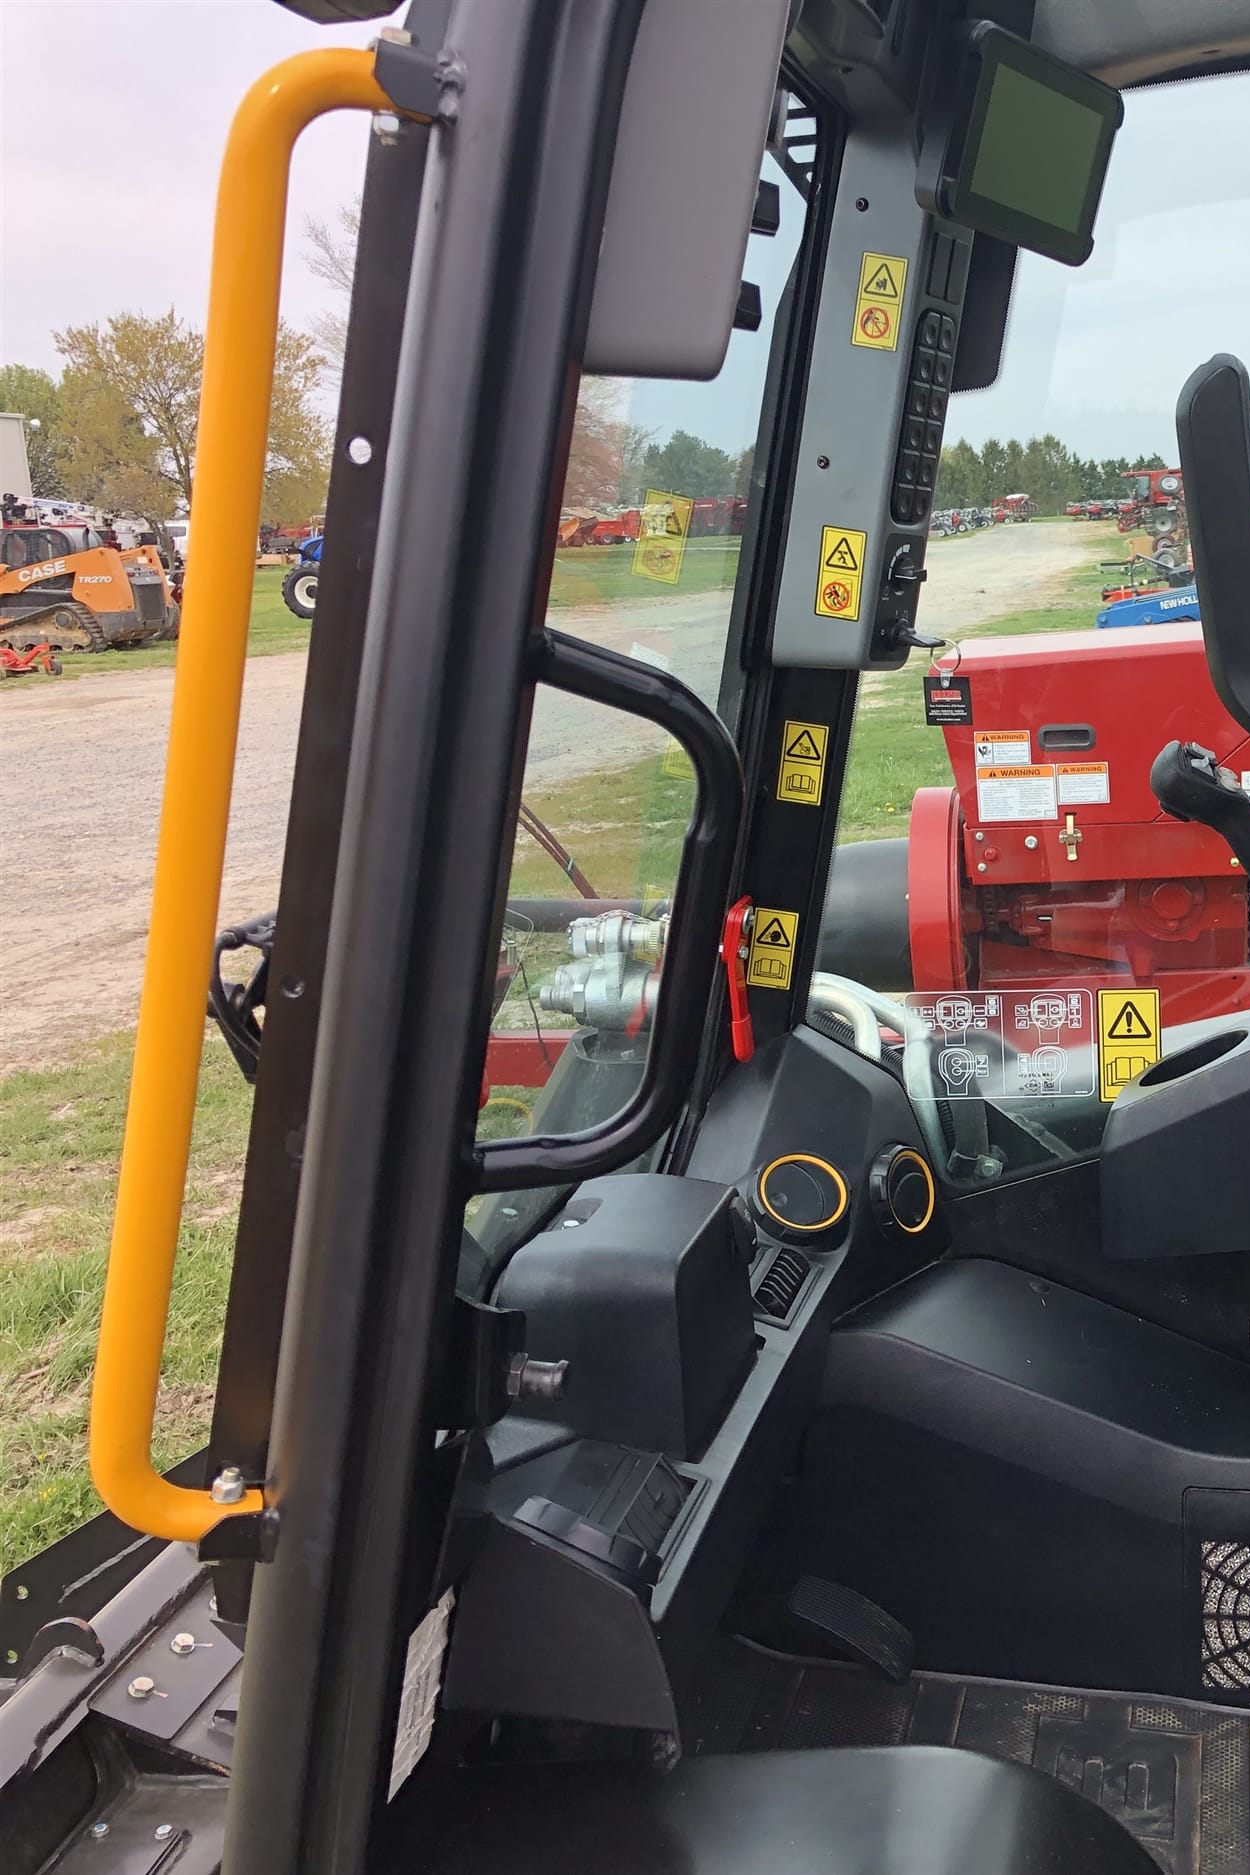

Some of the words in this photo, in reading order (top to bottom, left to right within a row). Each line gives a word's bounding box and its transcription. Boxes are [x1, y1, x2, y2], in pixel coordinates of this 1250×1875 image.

[18, 560, 66, 582] CASE
[78, 576, 112, 584] TR270
[1160, 599, 1177, 610] NEW
[1000, 768, 1041, 777] WARNING
